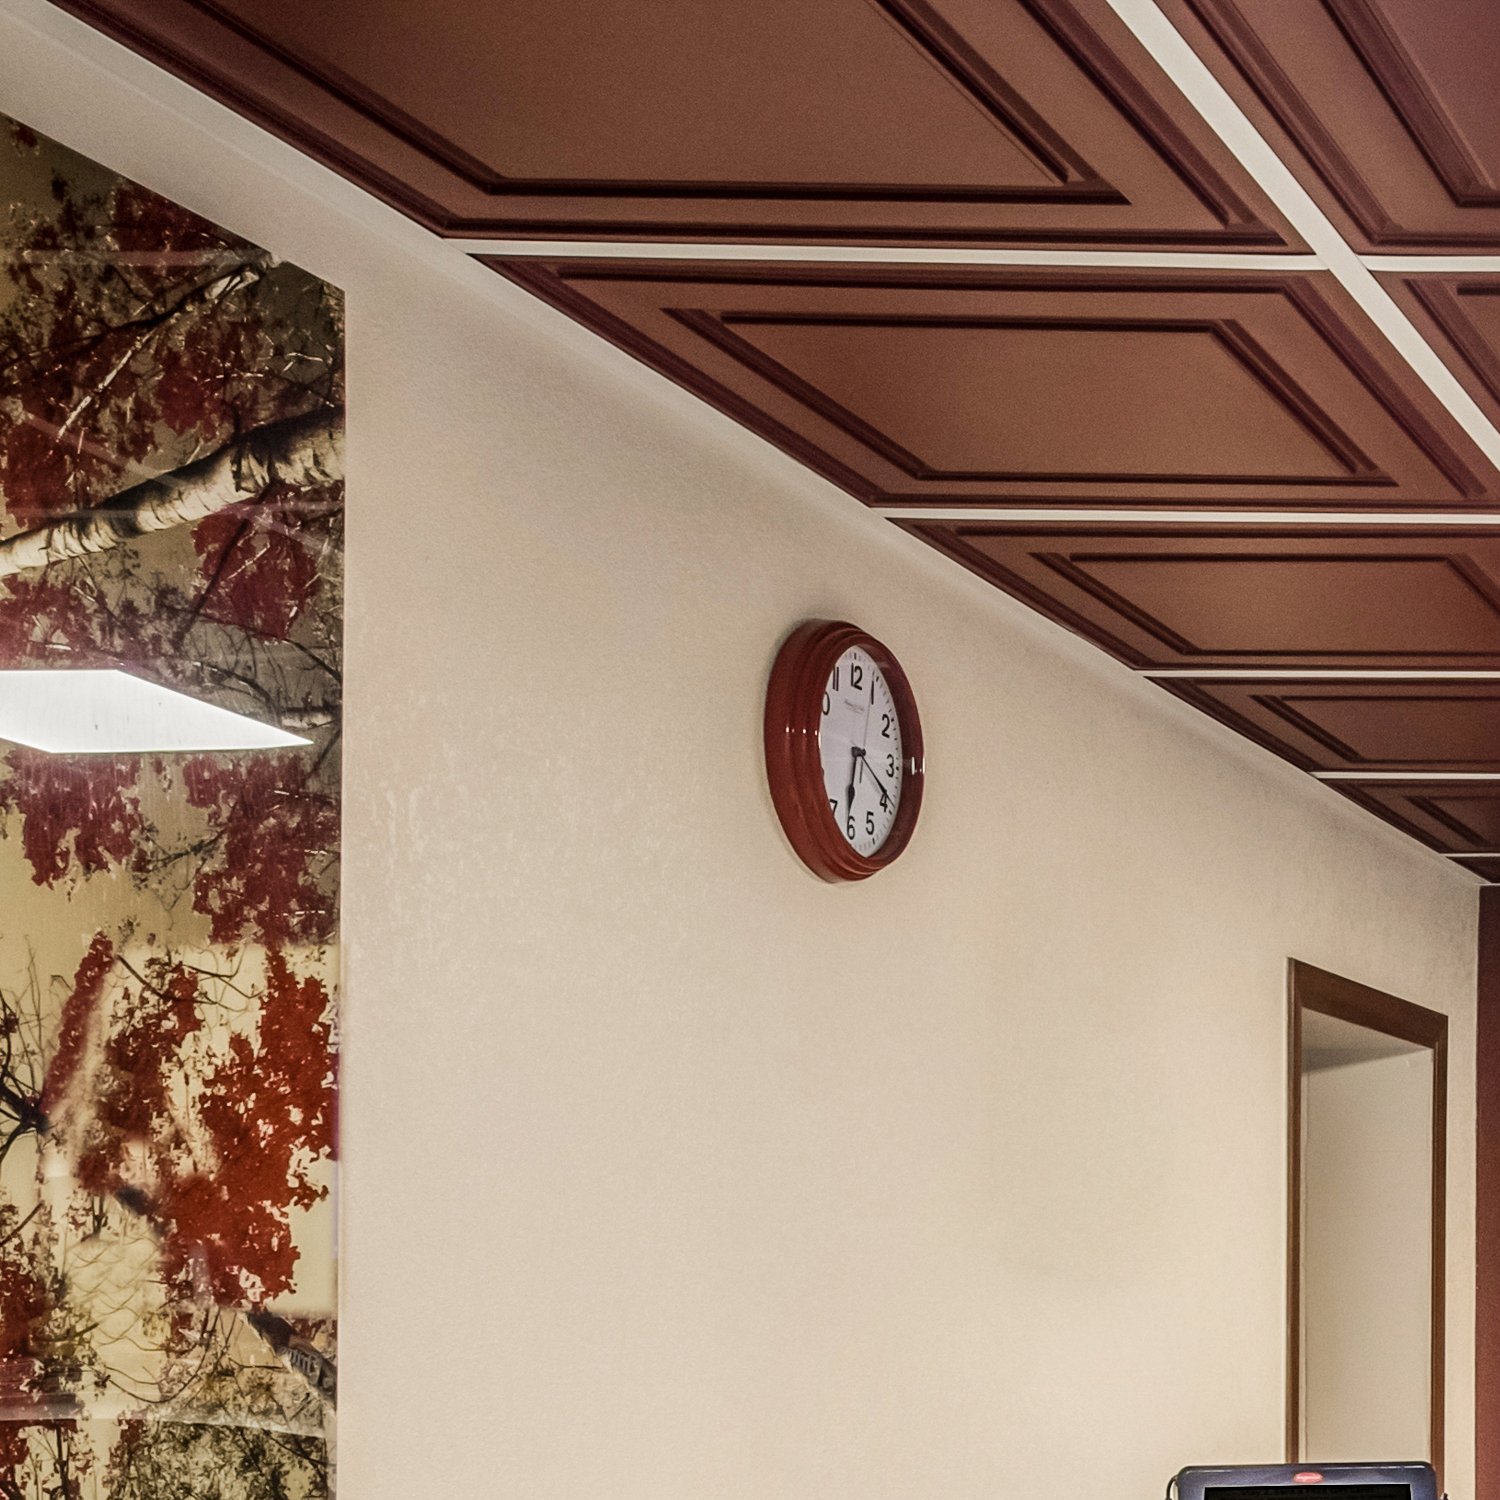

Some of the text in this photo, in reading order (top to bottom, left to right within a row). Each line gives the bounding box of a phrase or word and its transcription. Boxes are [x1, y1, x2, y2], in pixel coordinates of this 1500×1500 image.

[850, 663, 863, 691] 12
[881, 713, 891, 738] 2
[886, 754, 895, 778] 3
[879, 792, 888, 813] 4
[847, 815, 855, 841] 6
[865, 811, 875, 836] 5
